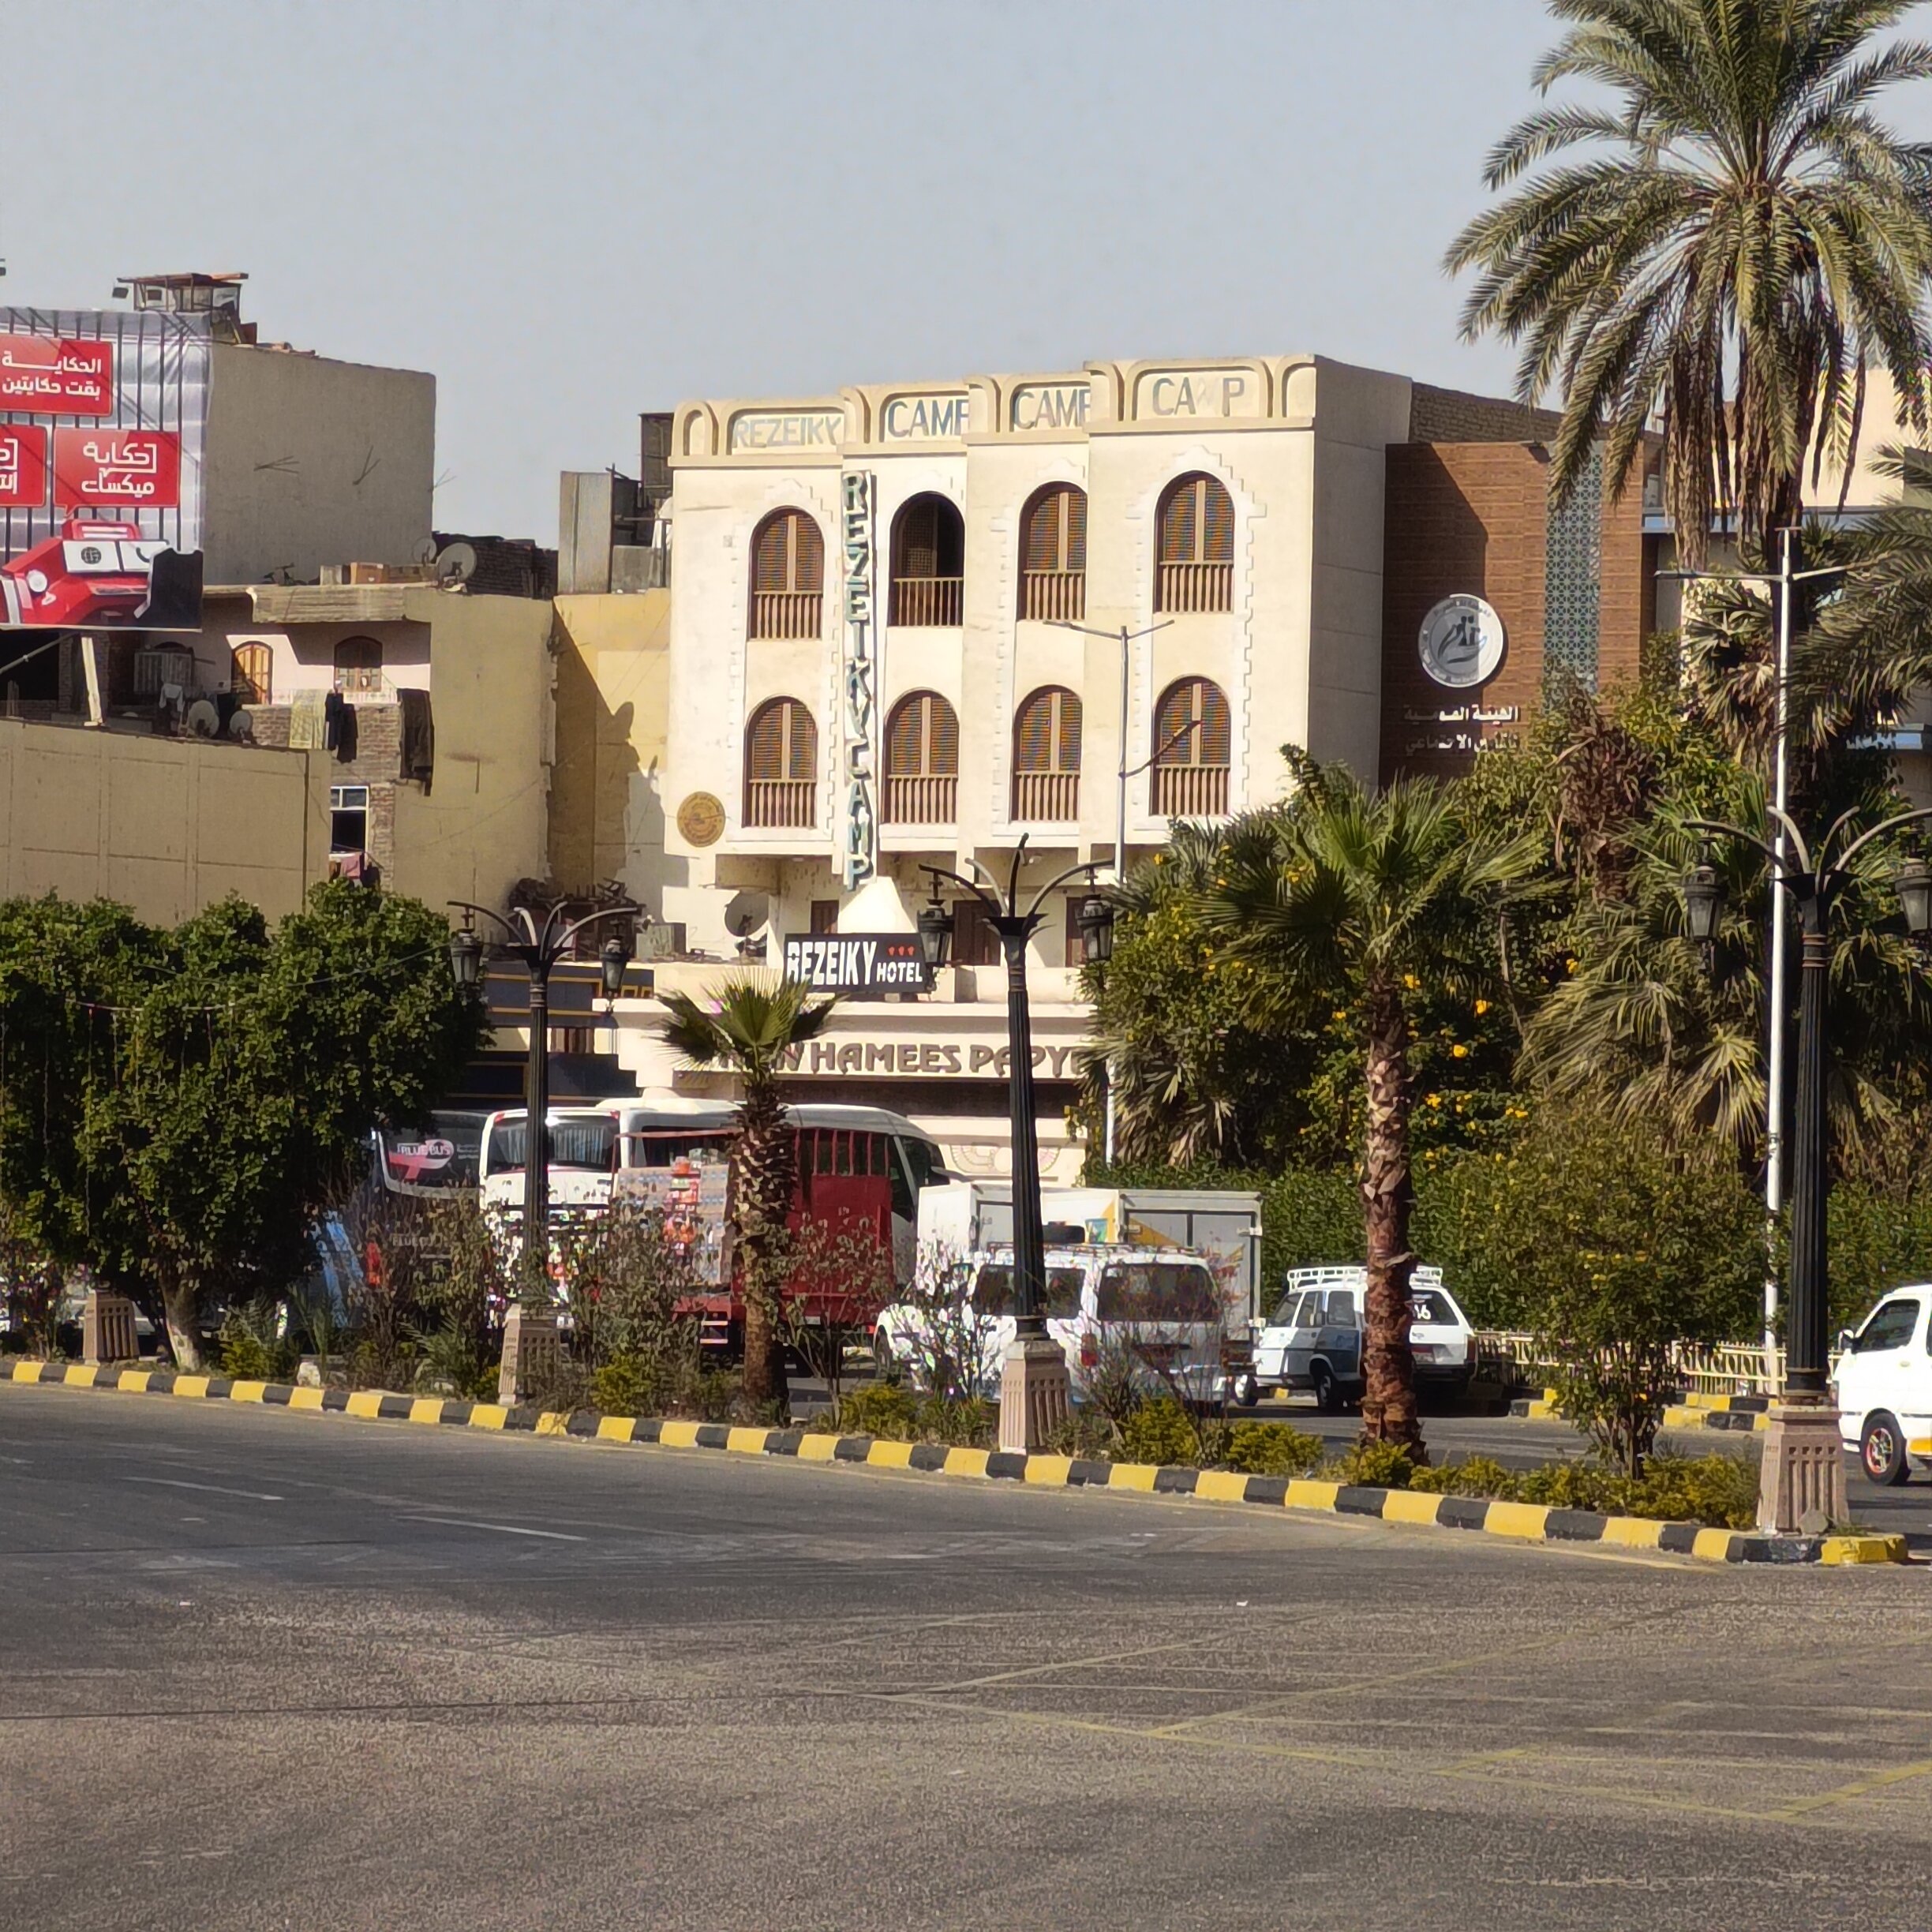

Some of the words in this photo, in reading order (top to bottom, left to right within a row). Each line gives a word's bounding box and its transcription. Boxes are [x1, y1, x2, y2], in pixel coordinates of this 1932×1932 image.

[2, 350, 102, 375] الحكاية
[2, 376, 62, 395] حكايتين
[66, 380, 100, 401] بقت
[732, 415, 842, 448] REZEIKY
[82, 442, 157, 475] حكاية
[81, 472, 155, 498] ميكسات
[842, 472, 869, 736] REZEIKY
[845, 737, 873, 892] CAMP
[786, 941, 878, 985] REZEIKY
[876, 961, 923, 983] HOTEL
[811, 1043, 962, 1074] HAMEES
